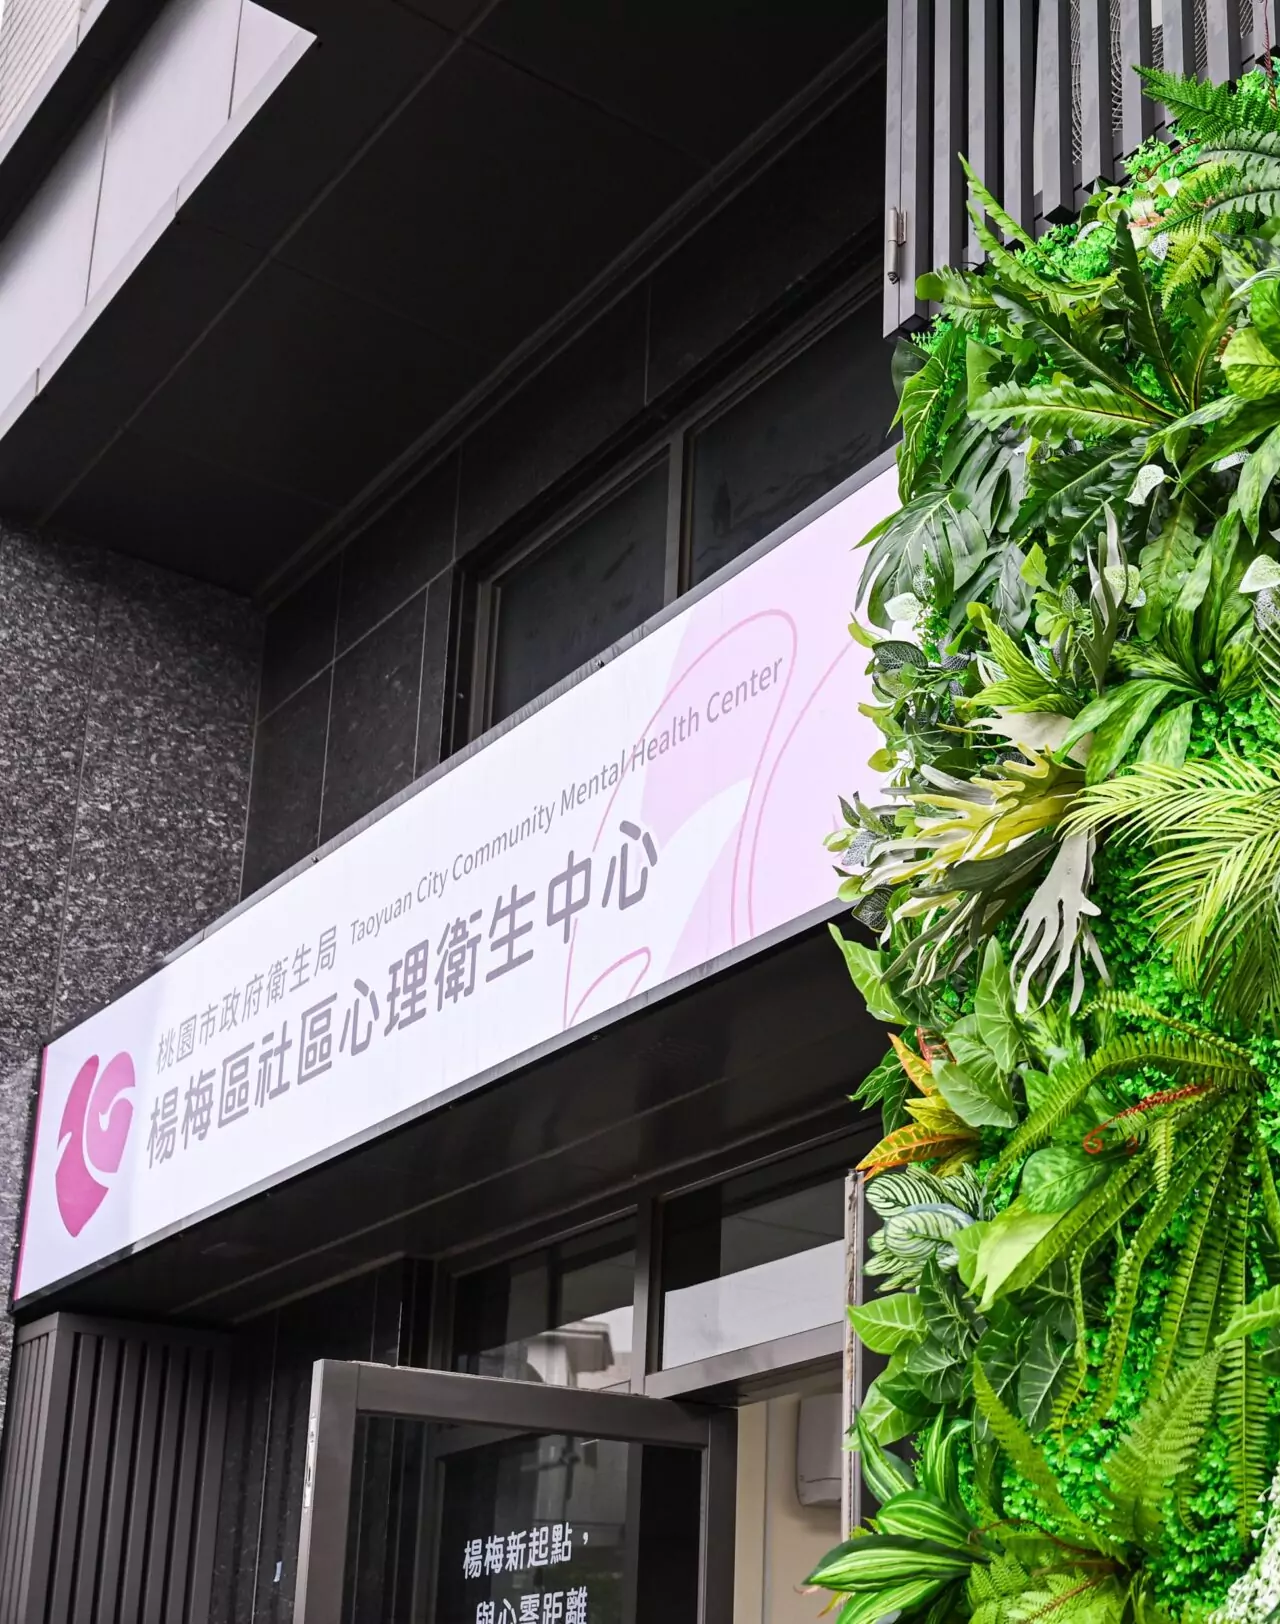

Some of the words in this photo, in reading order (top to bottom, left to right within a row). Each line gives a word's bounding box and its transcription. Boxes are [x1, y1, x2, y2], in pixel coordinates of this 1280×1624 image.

[350, 887, 413, 945] Taoyuan
[417, 868, 448, 904] City
[452, 799, 555, 882] Community
[560, 750, 627, 817] Mental
[631, 706, 699, 772] Health
[706, 657, 783, 723] Center
[146, 819, 658, 1170] 楊梅區社區心理衛生中心
[155, 925, 338, 1075] 桃園市政府衛生局
